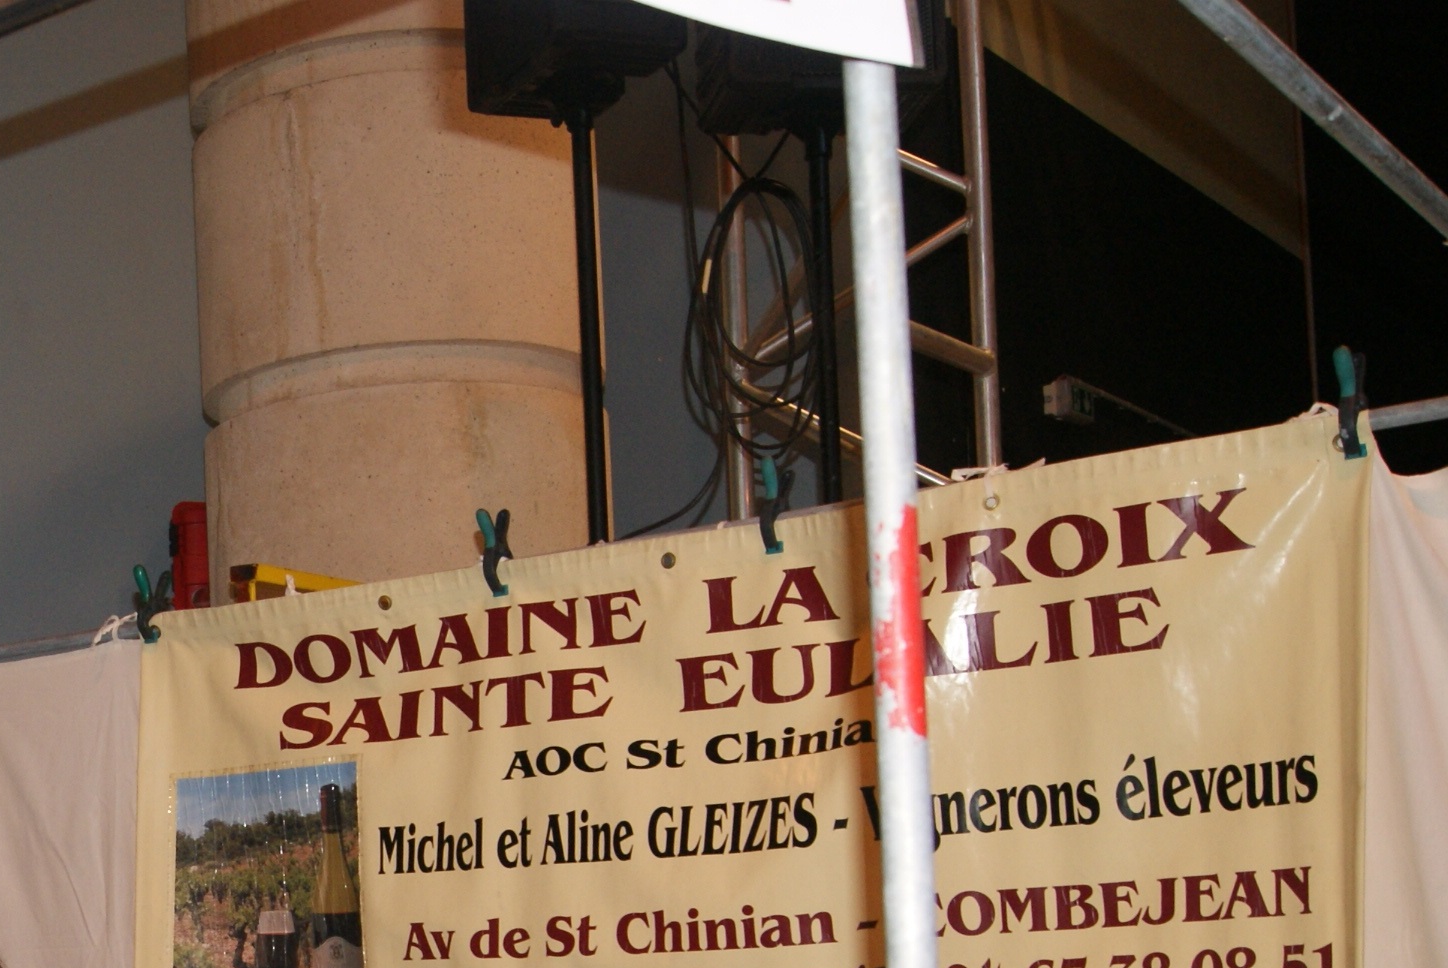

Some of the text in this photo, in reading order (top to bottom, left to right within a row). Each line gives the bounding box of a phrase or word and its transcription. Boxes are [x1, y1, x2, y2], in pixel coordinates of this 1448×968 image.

[234, 589, 647, 689] DOMAINE
[702, 566, 841, 634] LA
[279, 666, 613, 750] SAINTE
[502, 718, 876, 781] AOC St Chinia
[378, 817, 485, 875] Michel
[497, 816, 533, 869] et
[540, 809, 635, 865] Aline
[647, 792, 818, 859] GLEIZES
[860, 779, 1101, 853] Vnerons
[1116, 753, 1318, 821] éleveurs
[403, 922, 456, 960] Av
[469, 917, 531, 959] de
[545, 915, 598, 957] St
[616, 904, 838, 954] Chinian
